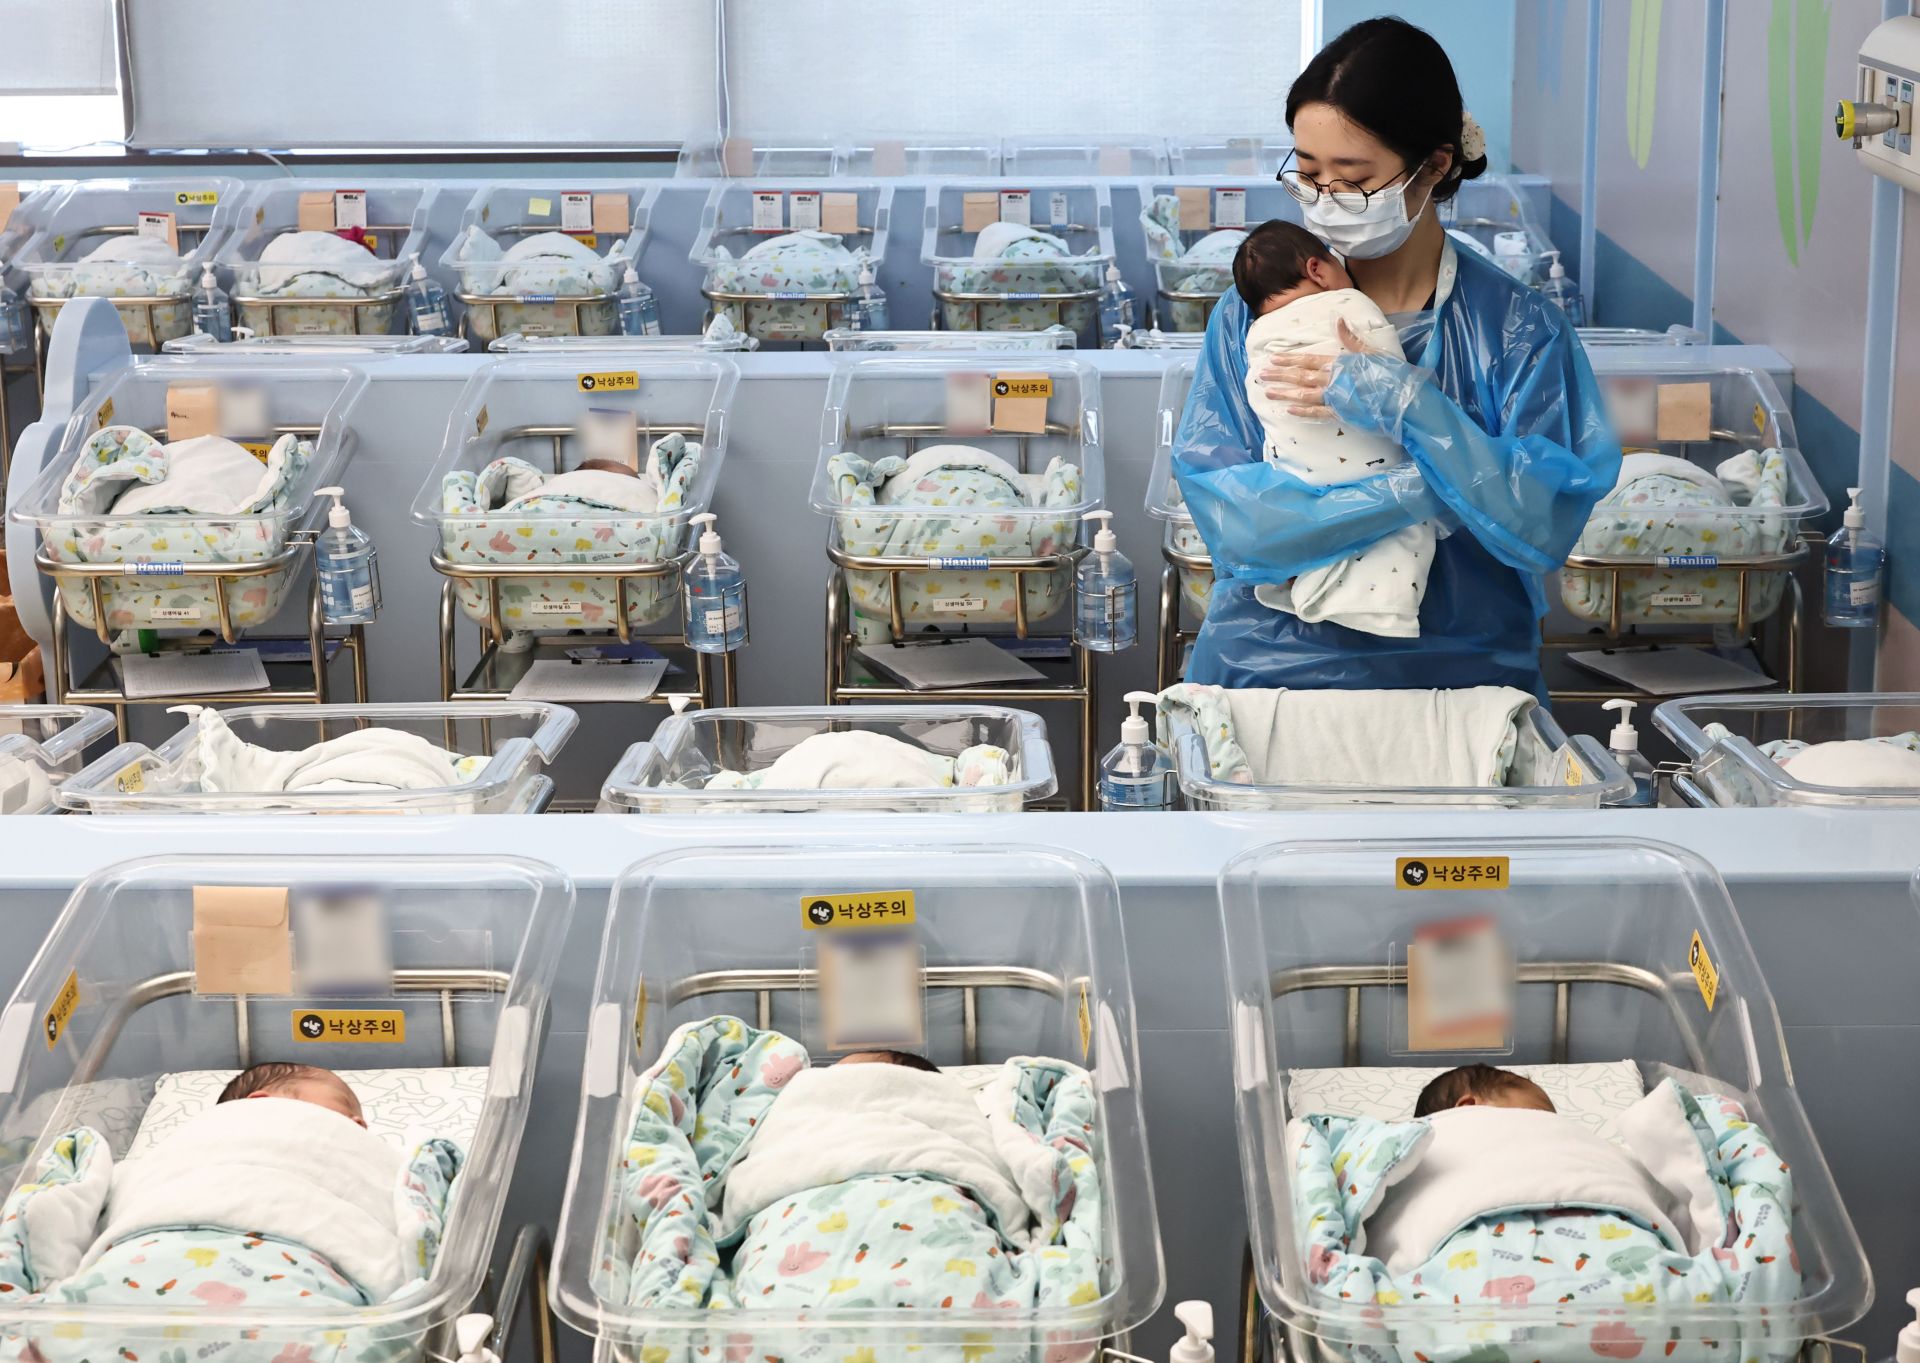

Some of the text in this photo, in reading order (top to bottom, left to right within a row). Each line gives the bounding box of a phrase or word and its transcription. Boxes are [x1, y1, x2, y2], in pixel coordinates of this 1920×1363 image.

[597, 375, 634, 387] 낙상주의
[1011, 384, 1048, 394] 낙상주의
[943, 557, 987, 566] Hanlim
[1670, 556, 1716, 565] Hanlim
[138, 563, 182, 571] Hanlim
[1433, 865, 1500, 882] 낙상주의
[838, 900, 906, 919] 낙상주의
[329, 1019, 396, 1036] 낙상주의
